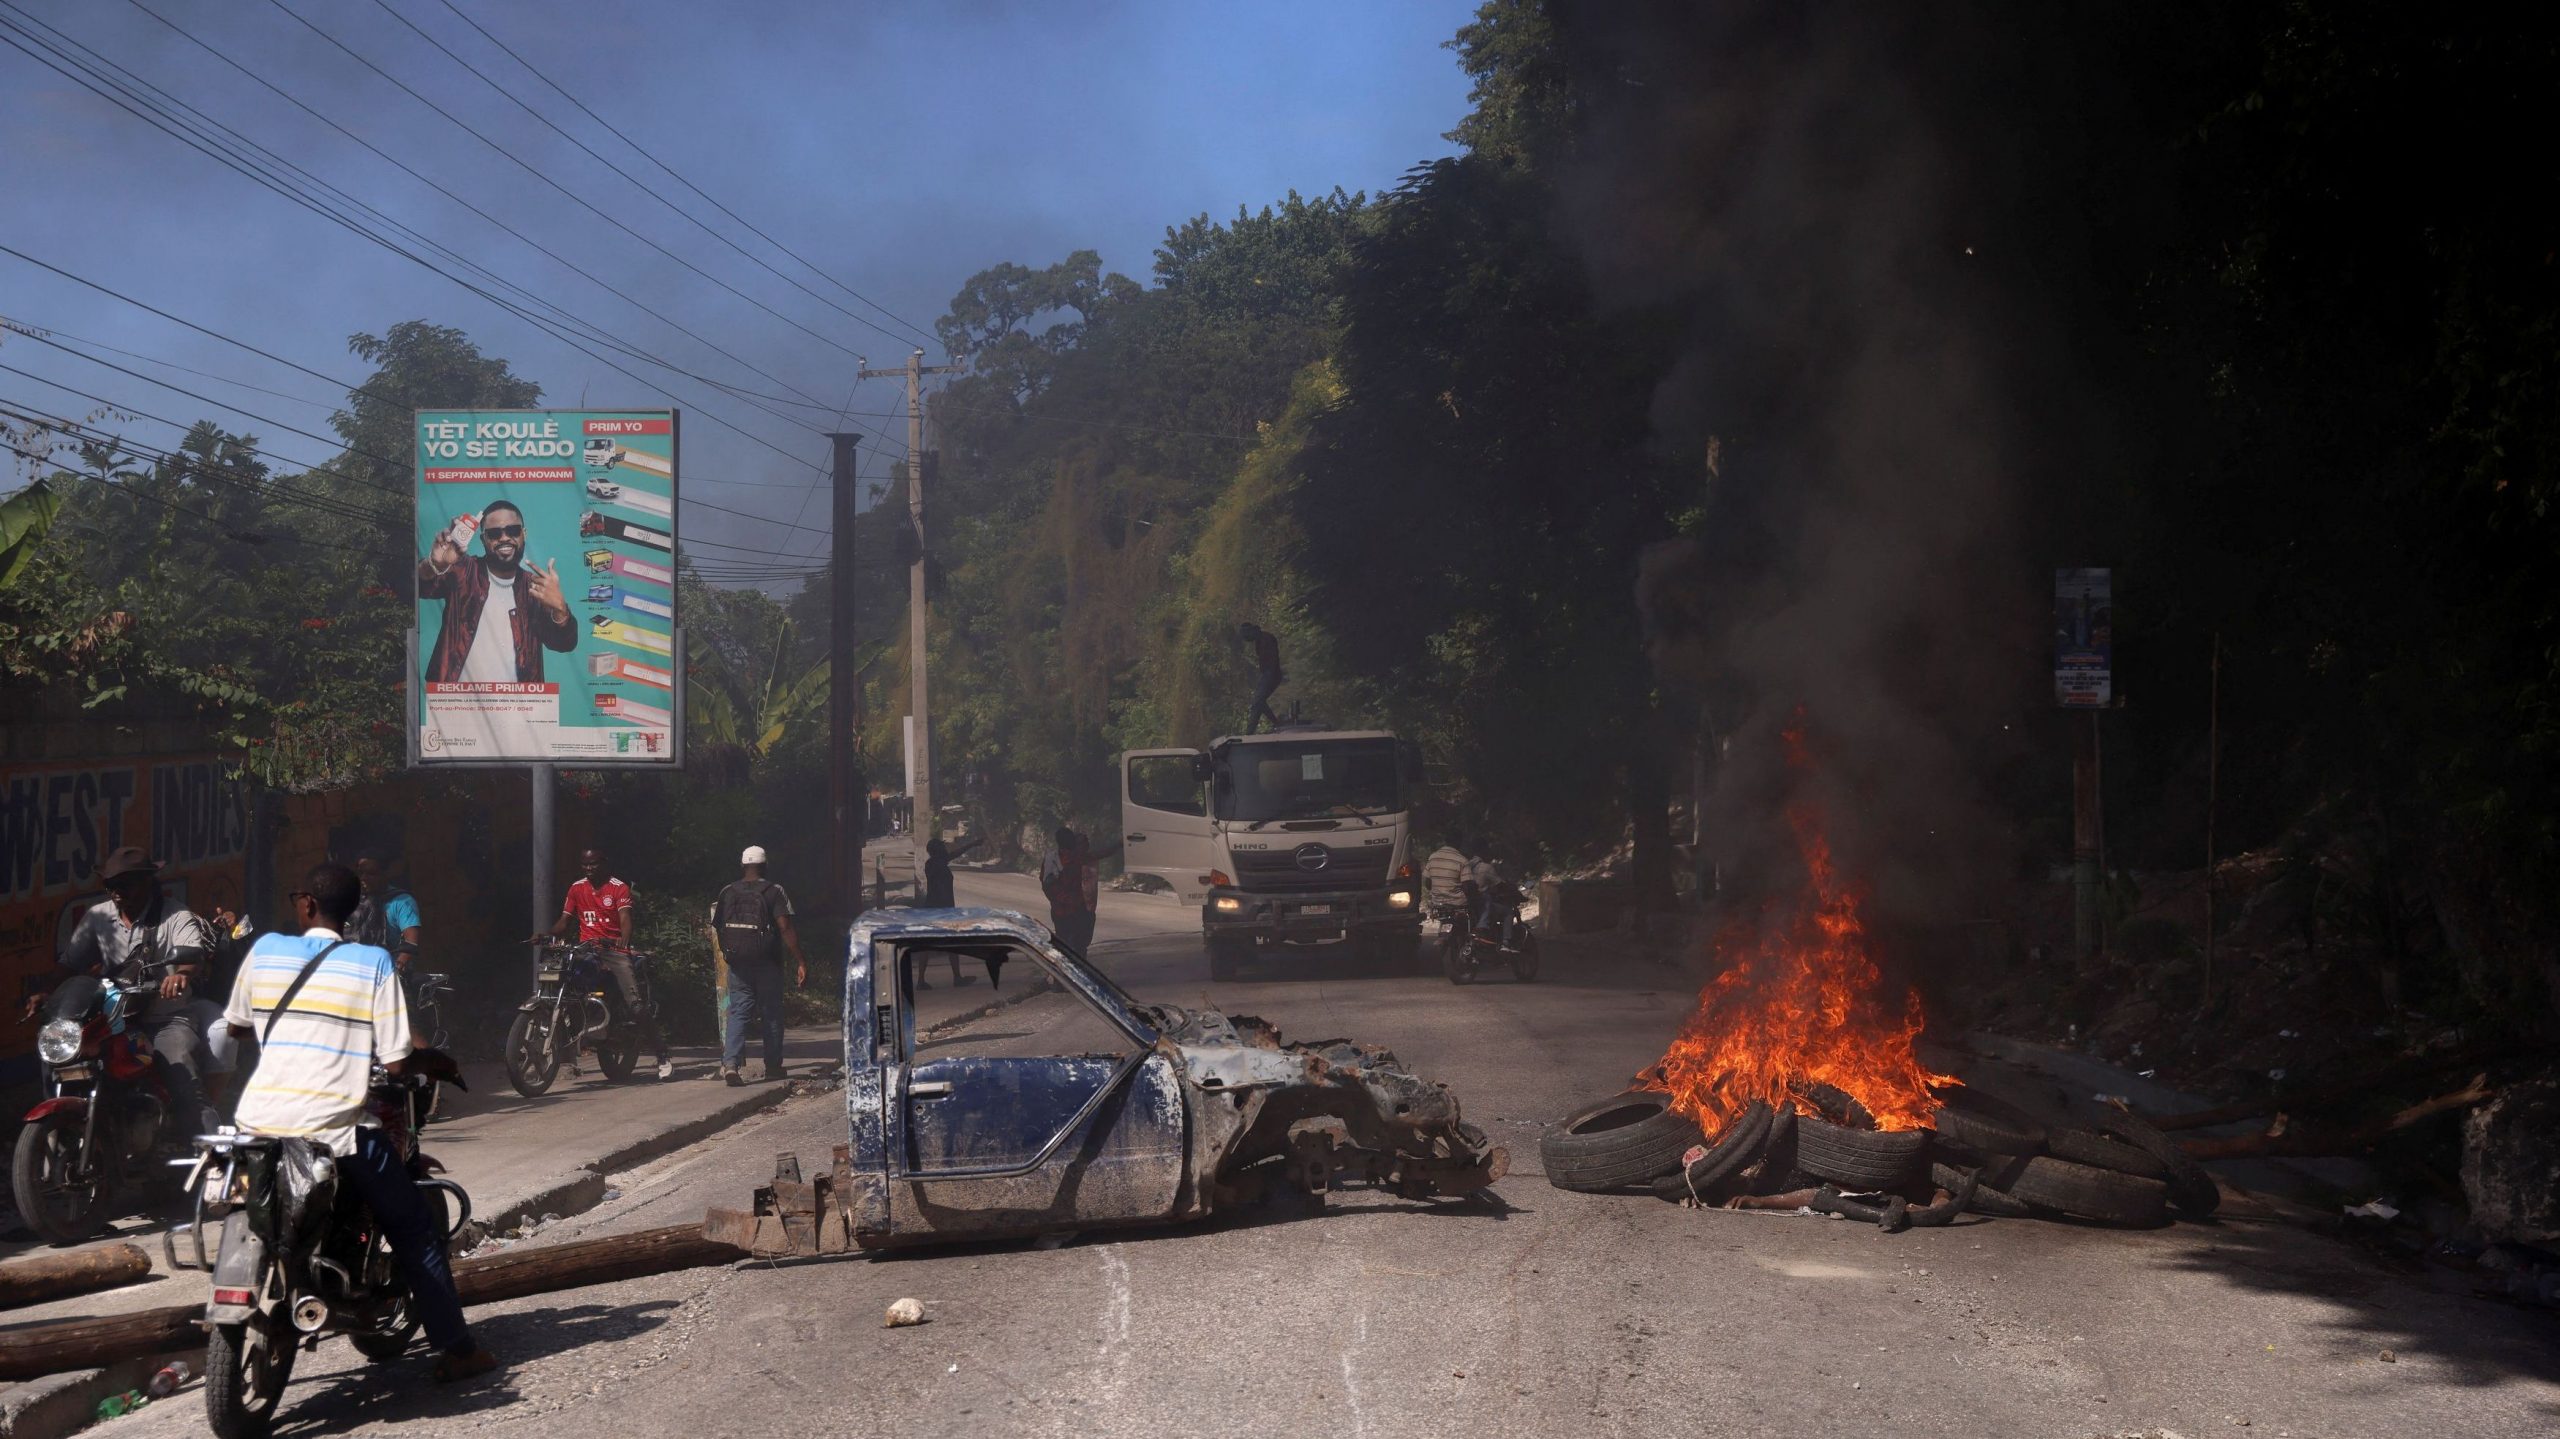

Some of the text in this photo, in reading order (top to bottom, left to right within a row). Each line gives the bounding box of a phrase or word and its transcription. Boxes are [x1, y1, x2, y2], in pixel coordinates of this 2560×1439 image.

[424, 418, 558, 439] TÈT KOULÈ
[589, 422, 643, 432] PRIM YO
[424, 440, 575, 458] YO SE KADO
[438, 471, 487, 479] SEPTANM
[489, 471, 512, 479] RIVE
[528, 471, 573, 479] NOVANM
[437, 684, 545, 693] REKLAME PRIM OU
[152, 763, 248, 863] INDIES
[583, 911, 596, 927] T
